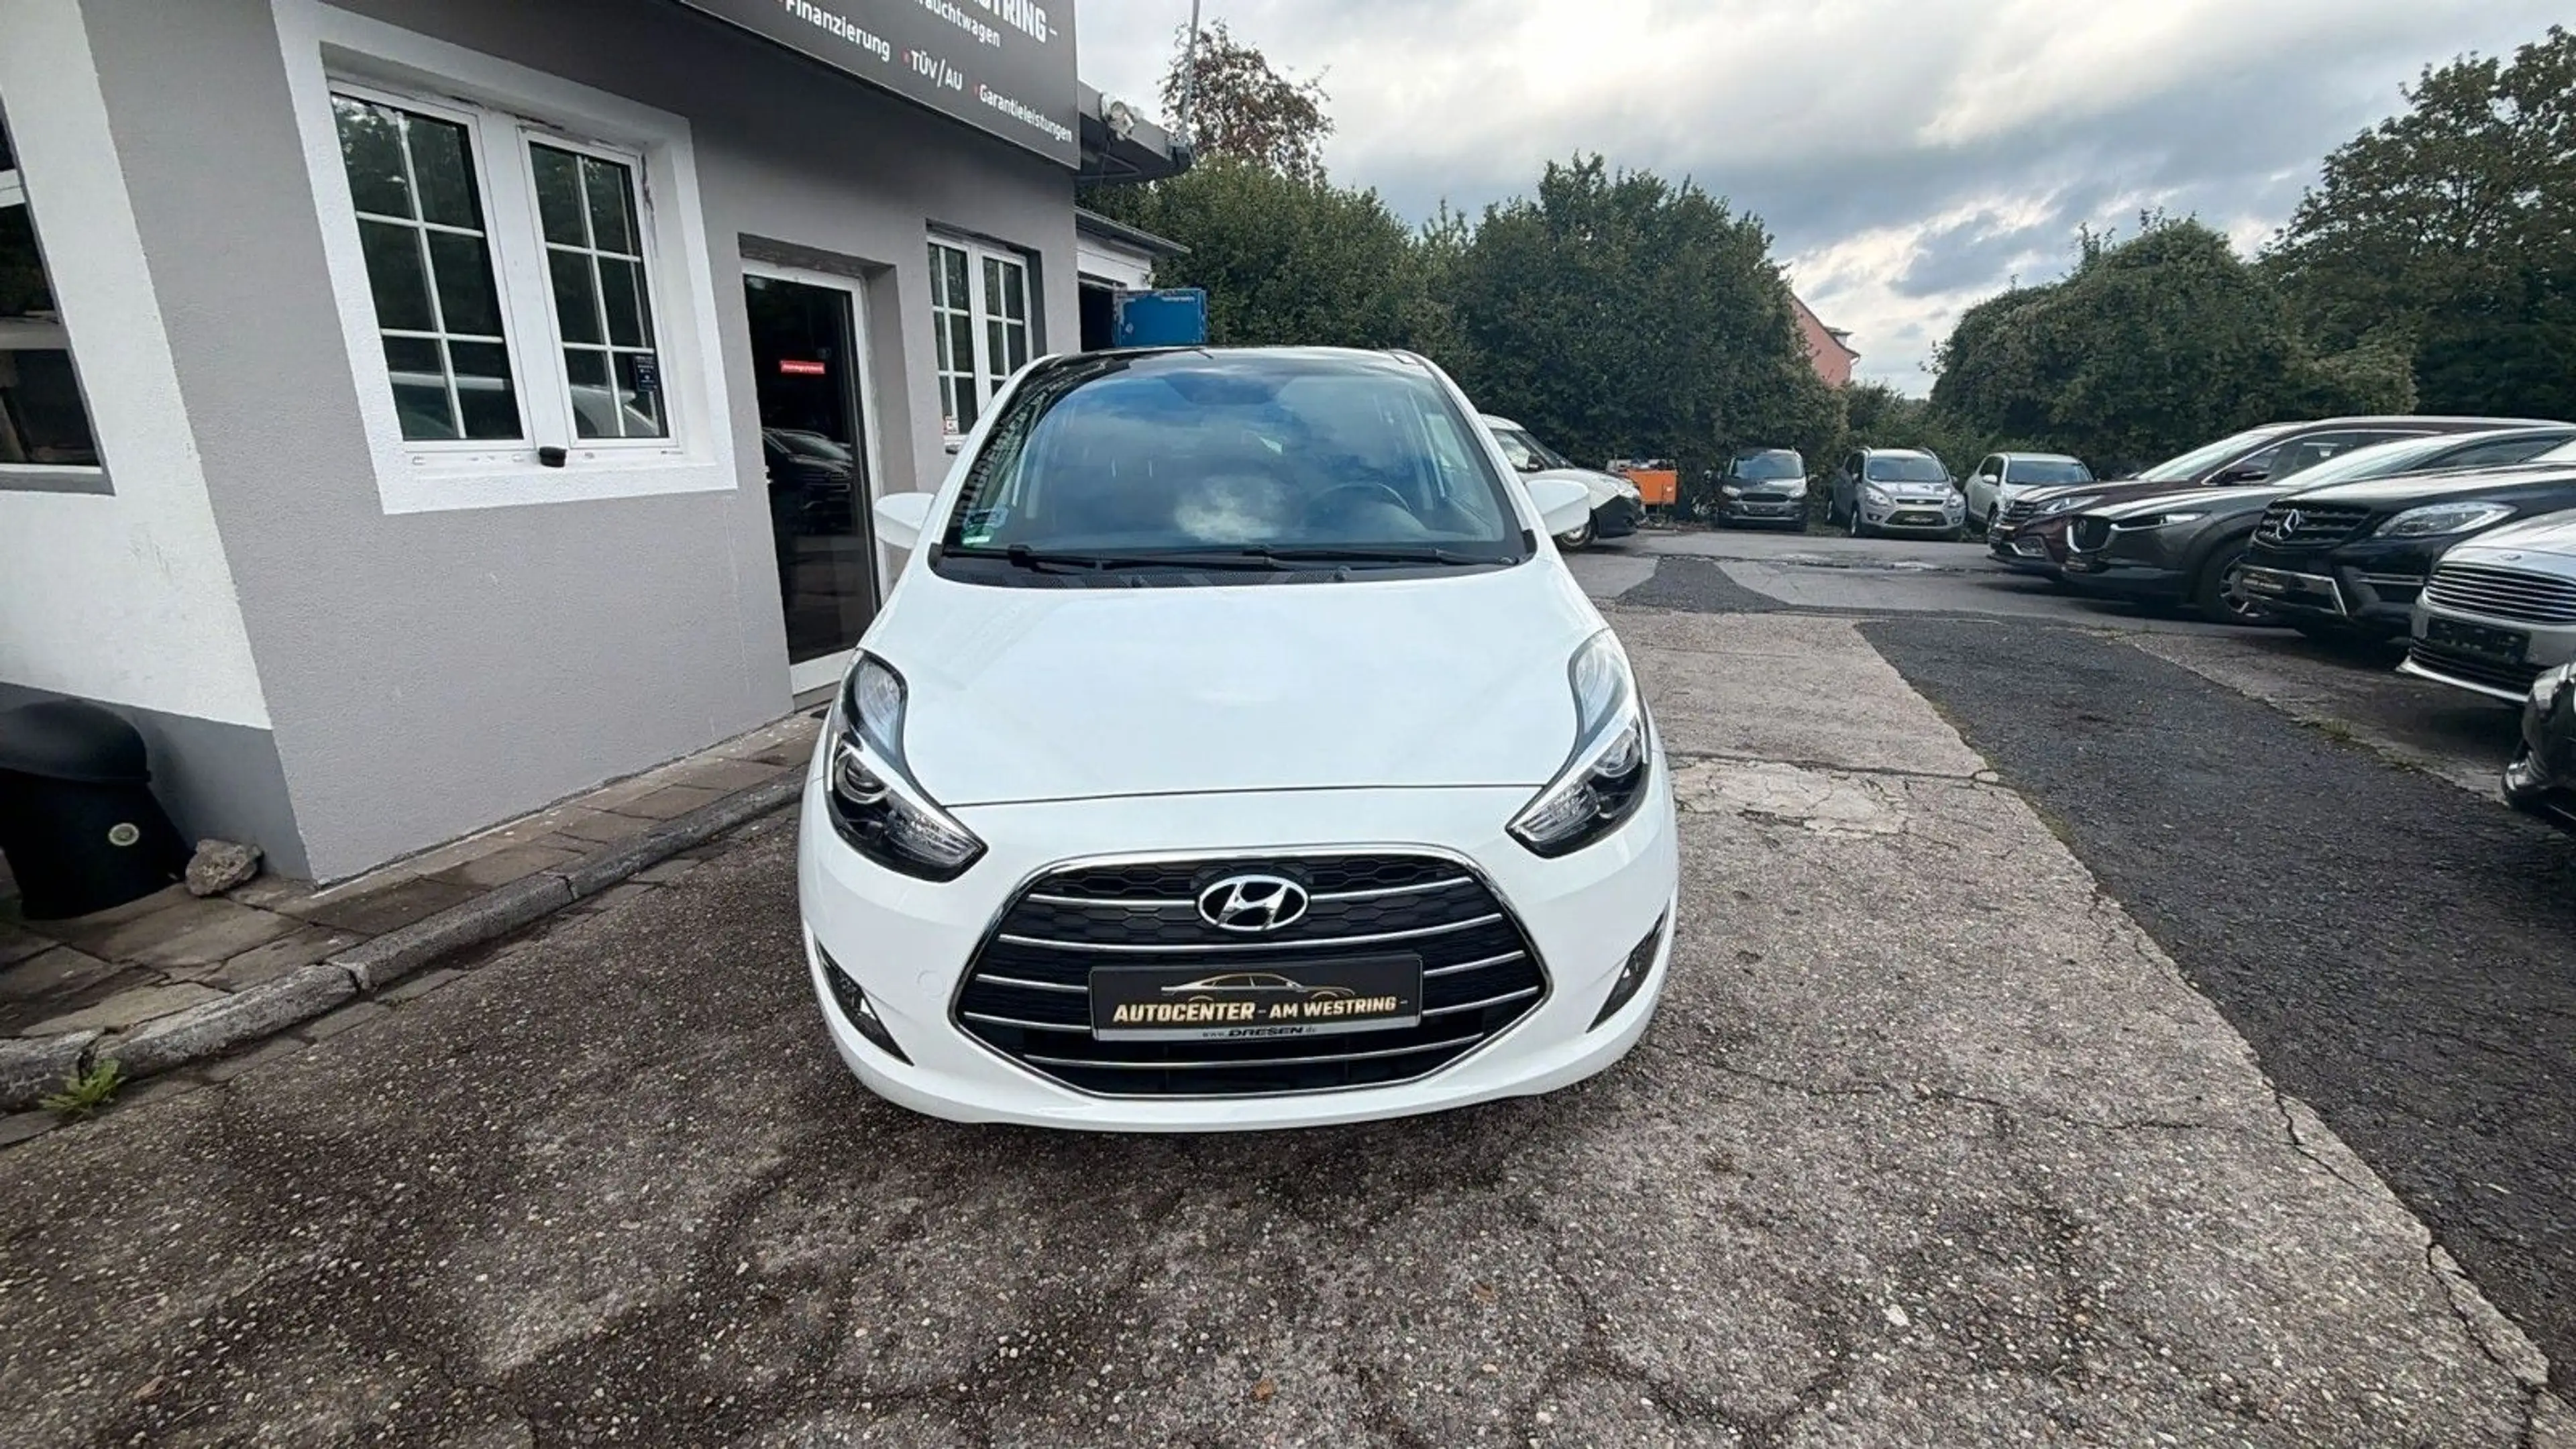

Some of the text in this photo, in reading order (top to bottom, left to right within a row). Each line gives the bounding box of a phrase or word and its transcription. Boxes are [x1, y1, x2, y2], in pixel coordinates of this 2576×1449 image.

[911, 50, 963, 91] TÜV/AU
[979, 84, 1072, 142] Garantieleistungen
[1112, 1002, 1256, 1022] AUTOCENTER
[1269, 1003, 1298, 1018] AM
[1303, 997, 1397, 1017] WESTRING
